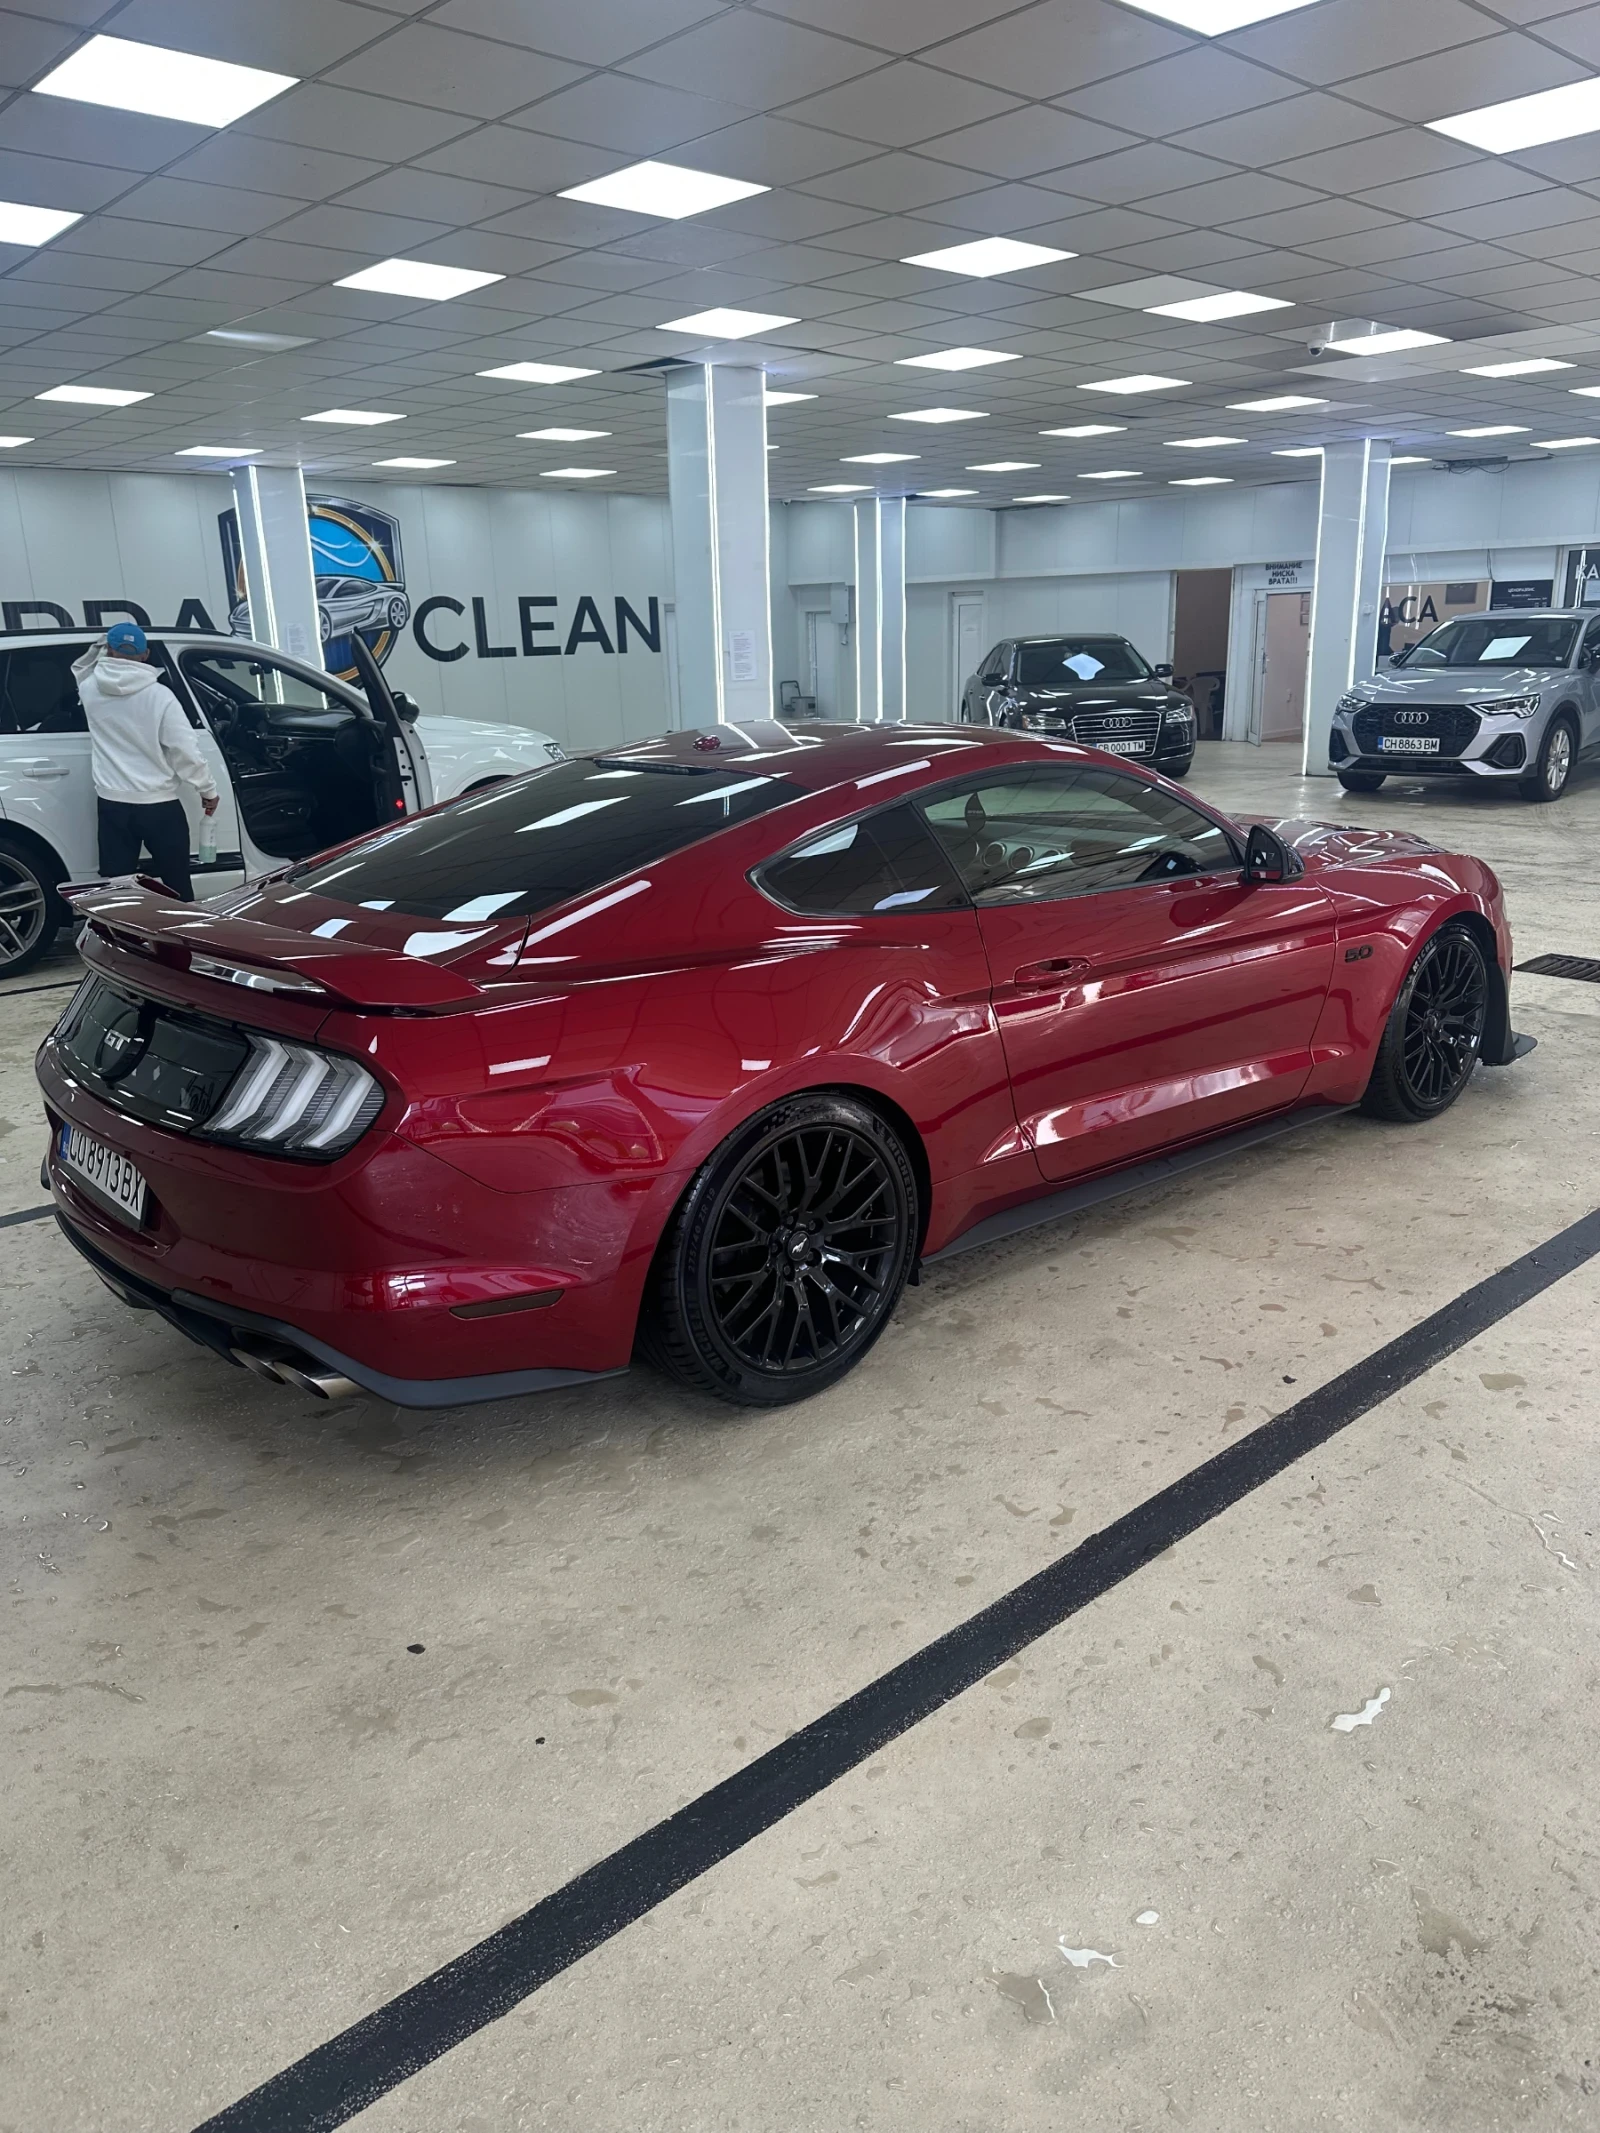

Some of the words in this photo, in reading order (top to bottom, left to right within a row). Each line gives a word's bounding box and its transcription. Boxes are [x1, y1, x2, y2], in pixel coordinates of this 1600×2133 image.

[1265, 561, 1303, 571] ВНИМАНИЕ
[413, 596, 661, 662] CLEAN
[104, 1029, 131, 1051] GT
[886, 1136, 915, 1215] MICHELIN
